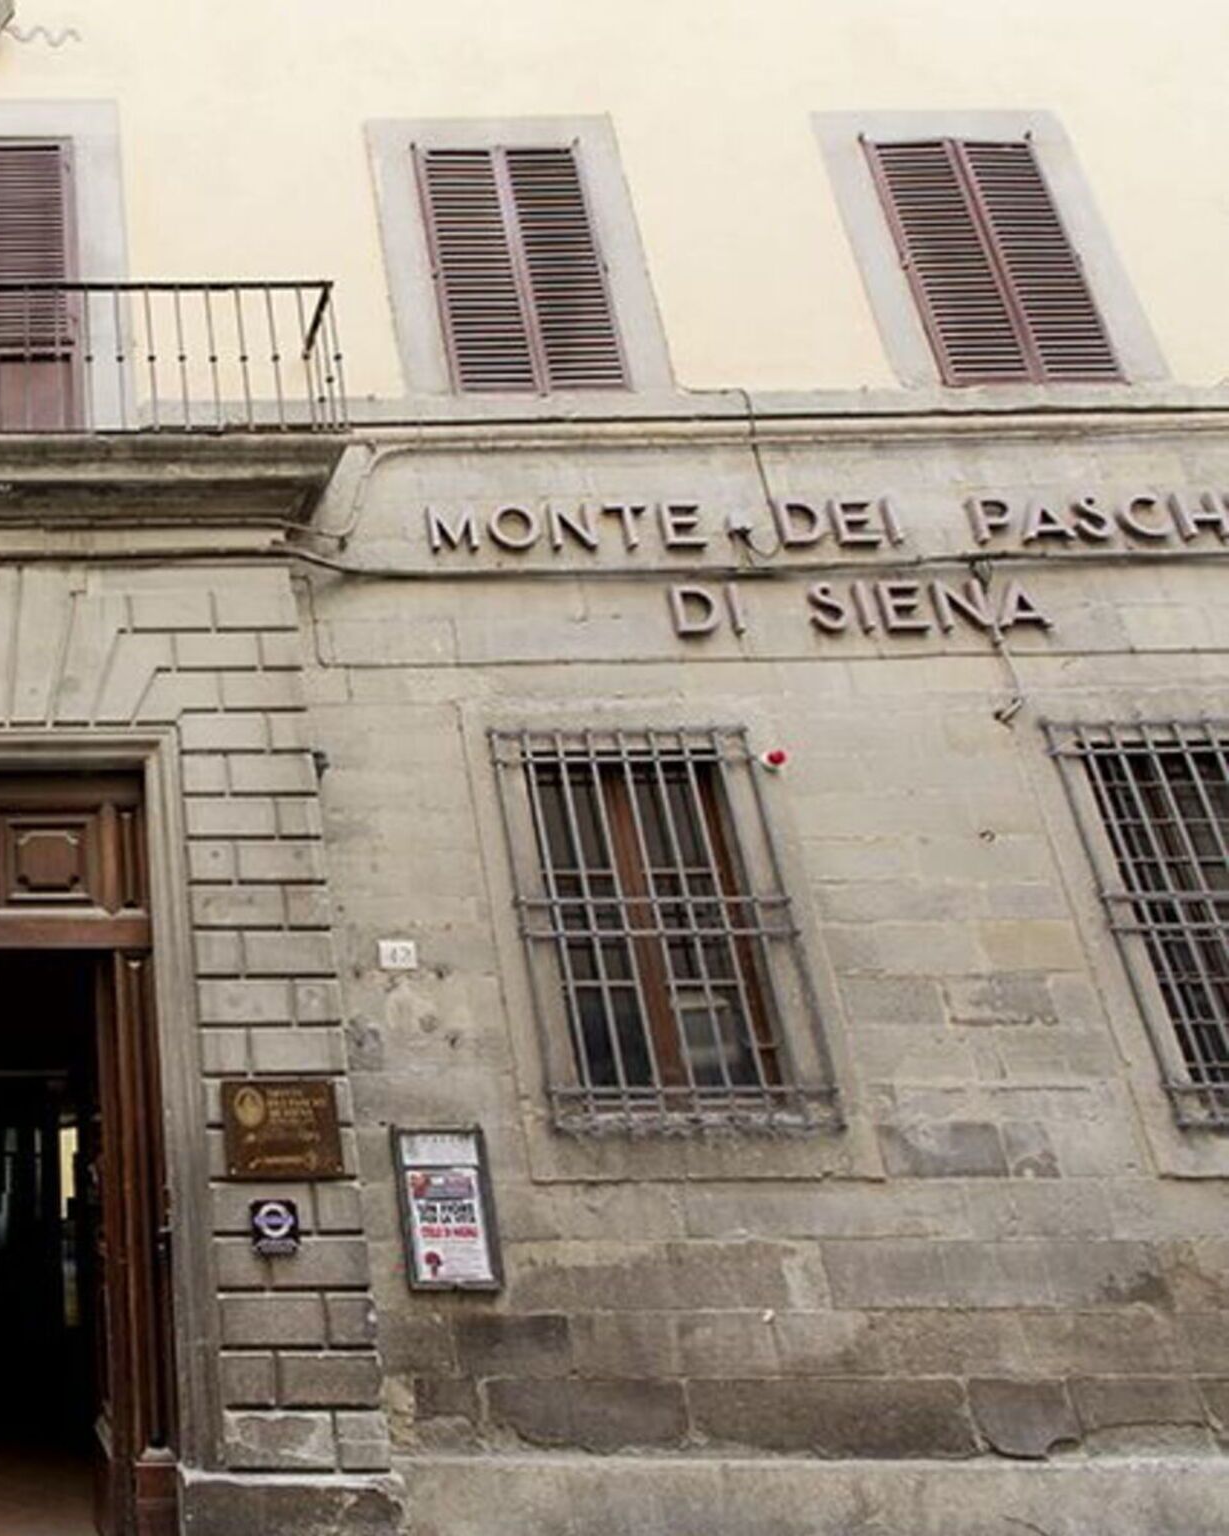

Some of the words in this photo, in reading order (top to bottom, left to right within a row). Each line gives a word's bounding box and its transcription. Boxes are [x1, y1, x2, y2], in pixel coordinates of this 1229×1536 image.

[425, 499, 709, 552] MONTE
[773, 495, 906, 548] DEI
[967, 491, 1229, 547] PASCH
[668, 582, 747, 637] DI
[808, 577, 1054, 635] SIENA
